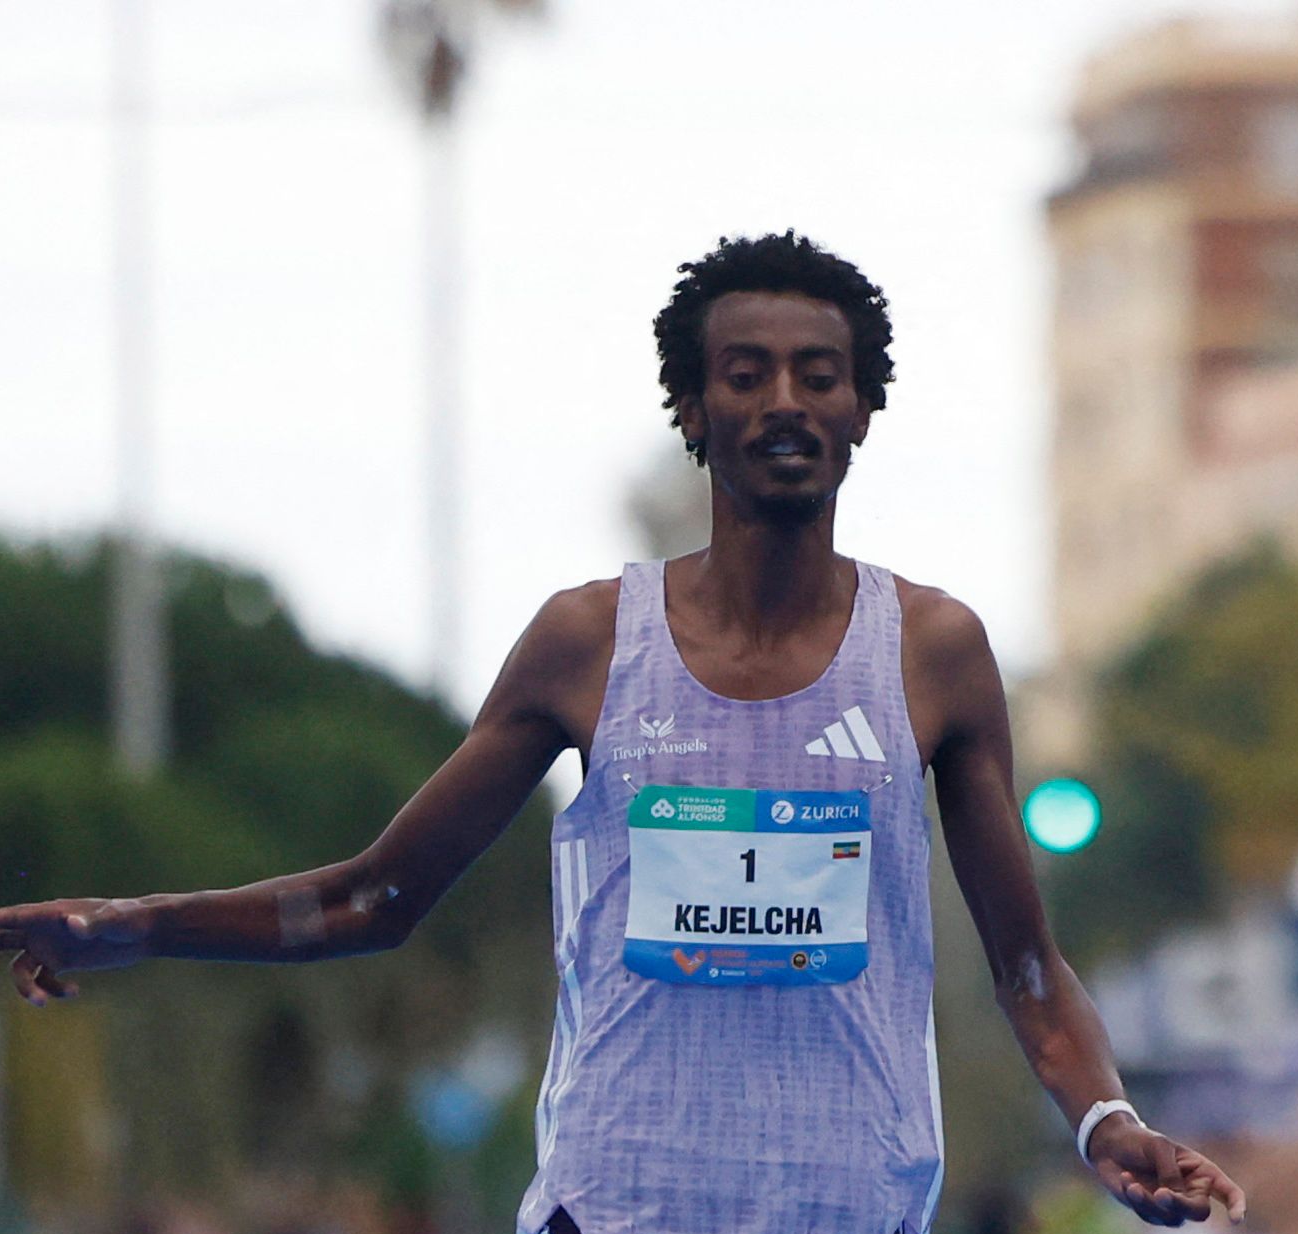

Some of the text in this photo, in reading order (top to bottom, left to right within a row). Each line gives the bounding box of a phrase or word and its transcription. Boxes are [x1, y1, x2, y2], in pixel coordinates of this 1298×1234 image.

[658, 738, 708, 755] Angels
[801, 805, 859, 820] ZURICH
[740, 848, 756, 883] 1
[674, 904, 823, 935] KEJELCHA
